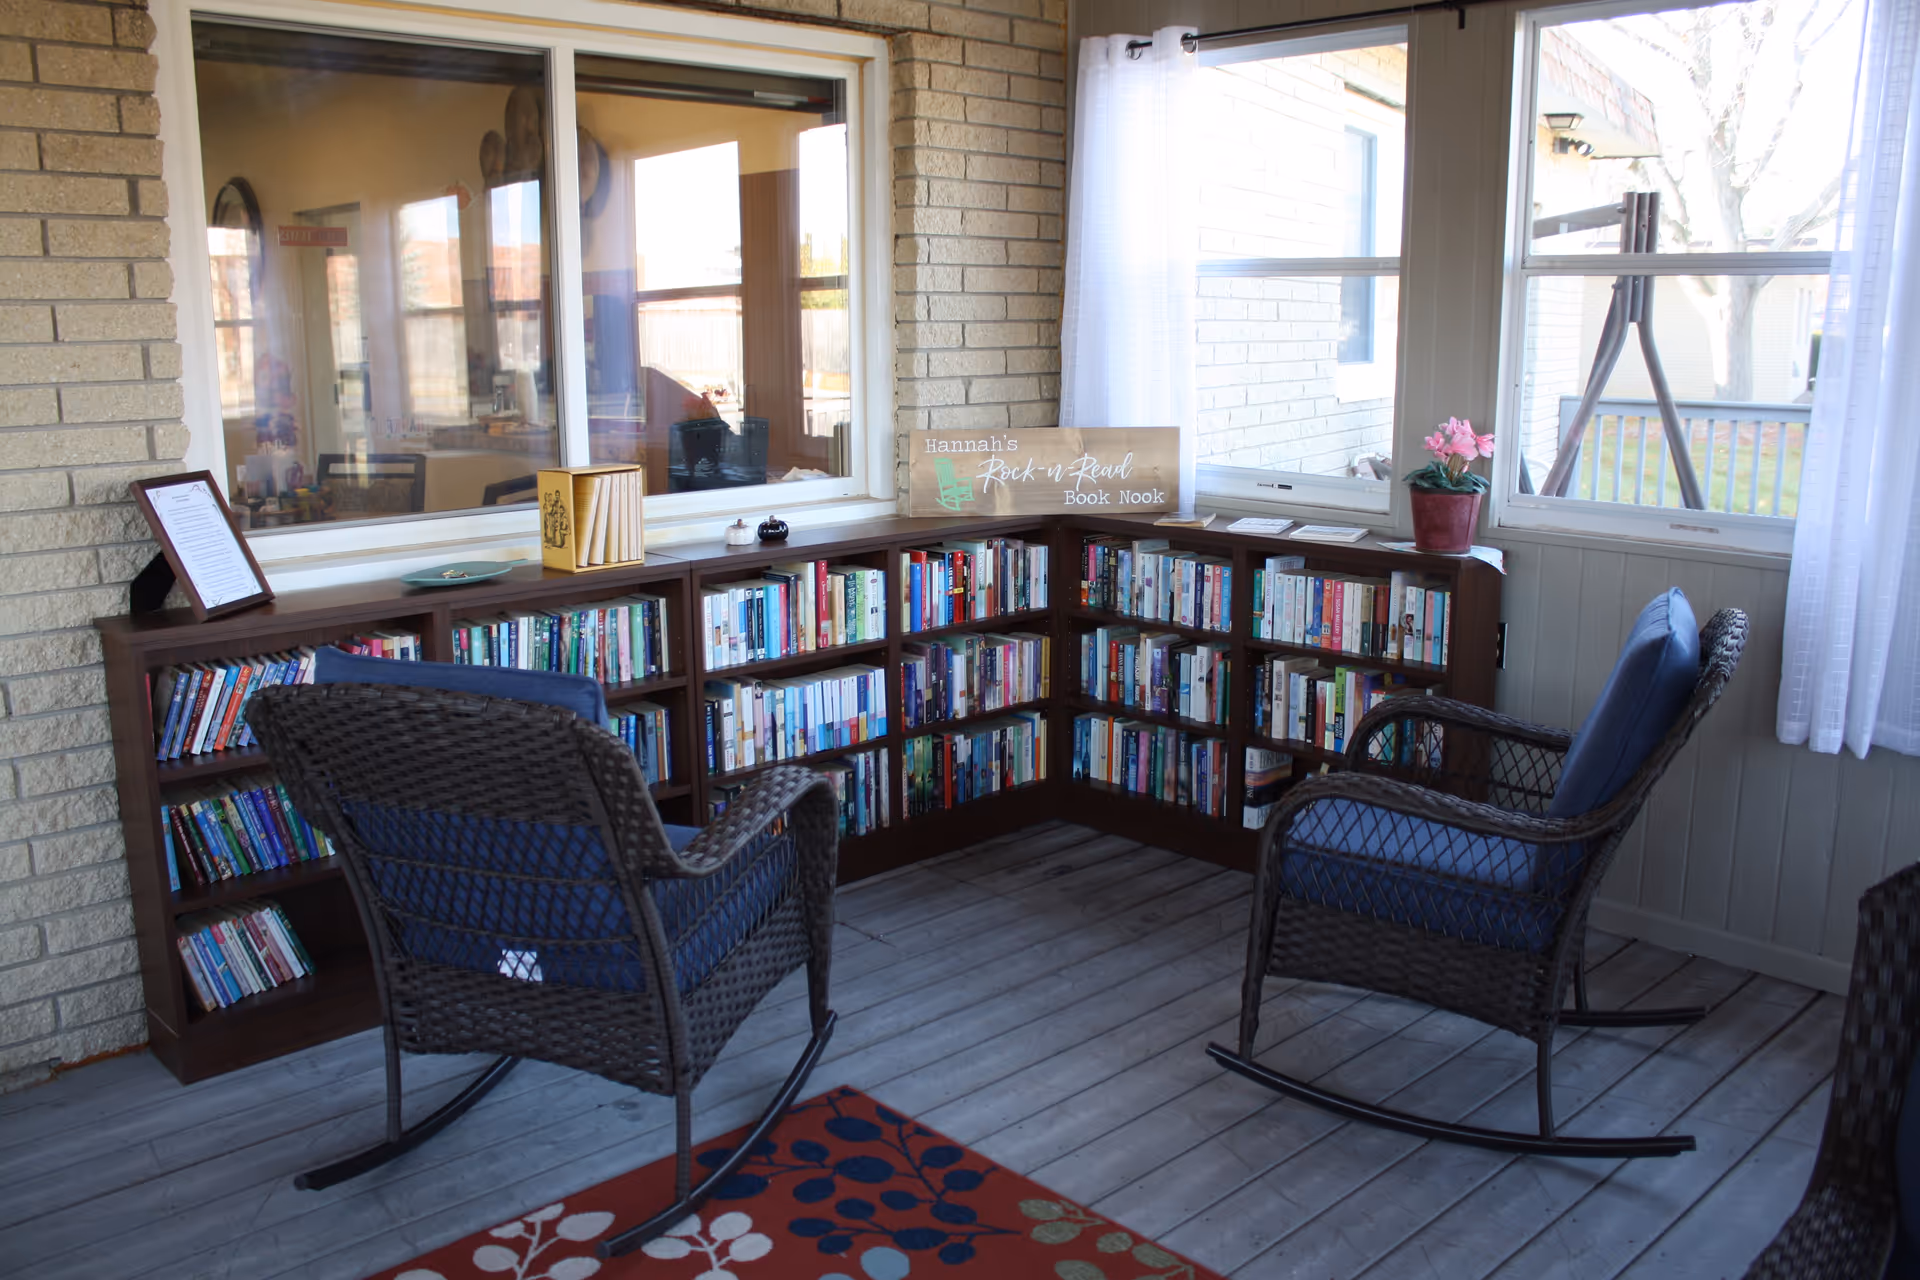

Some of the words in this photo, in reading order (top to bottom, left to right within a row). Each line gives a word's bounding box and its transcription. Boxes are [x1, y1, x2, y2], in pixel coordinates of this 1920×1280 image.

[925, 434, 1018, 454] Hannah's
[976, 452, 1133, 494] Rock-n-Read
[1064, 490, 1111, 505] Book
[1119, 488, 1165, 504] Nook
